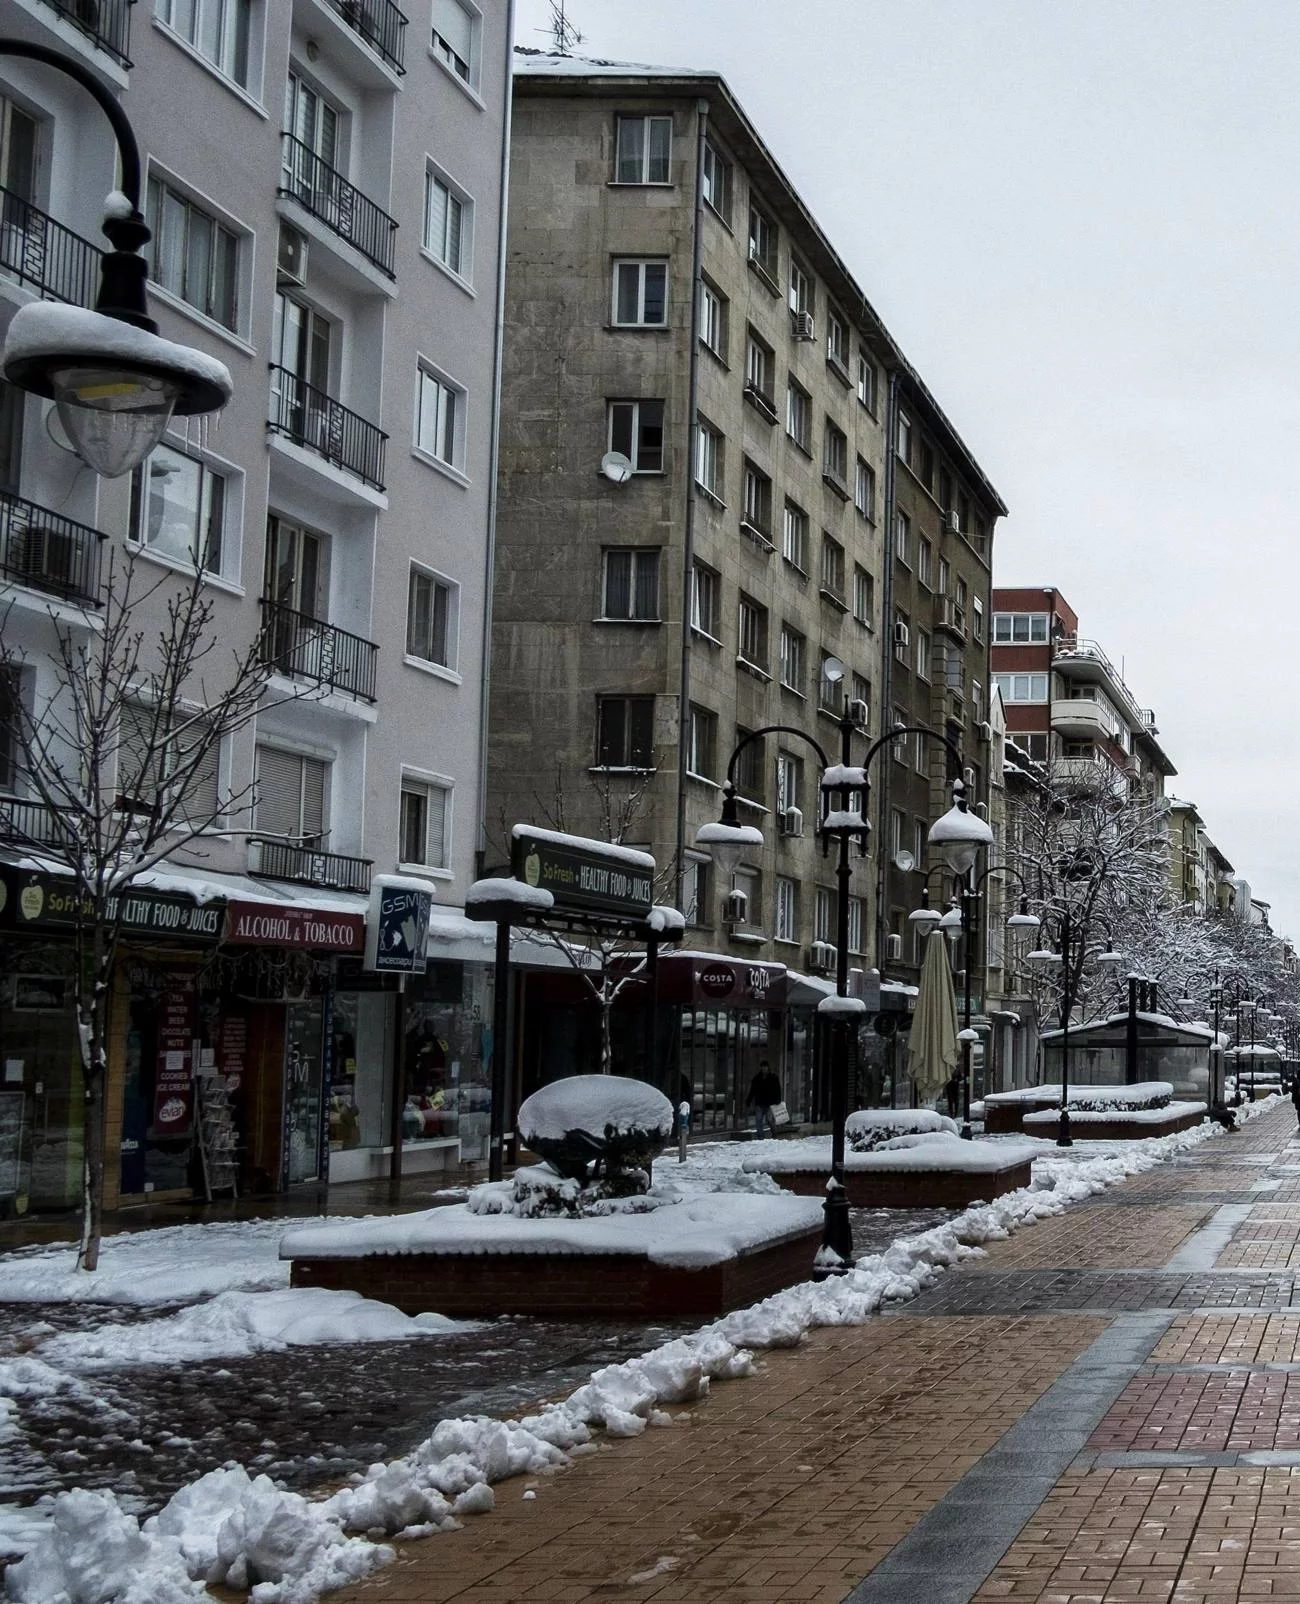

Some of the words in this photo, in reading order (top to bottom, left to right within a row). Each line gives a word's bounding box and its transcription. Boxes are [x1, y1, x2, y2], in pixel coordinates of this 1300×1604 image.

[580, 864, 609, 893] HEALTHY
[610, 872, 626, 898] FOOD
[627, 880, 632, 894] &
[632, 877, 651, 903] JUICES
[382, 892, 421, 915] GSM
[153, 903, 180, 928] FOOD
[180, 910, 188, 926] &
[187, 908, 219, 934] JUICES
[236, 915, 292, 941] ALCOHOL
[294, 927, 300, 941] &
[304, 921, 354, 945] TOBACCO
[703, 974, 733, 983] COSTA
[749, 968, 770, 989] COSTA
[161, 1104, 184, 1119] evian
